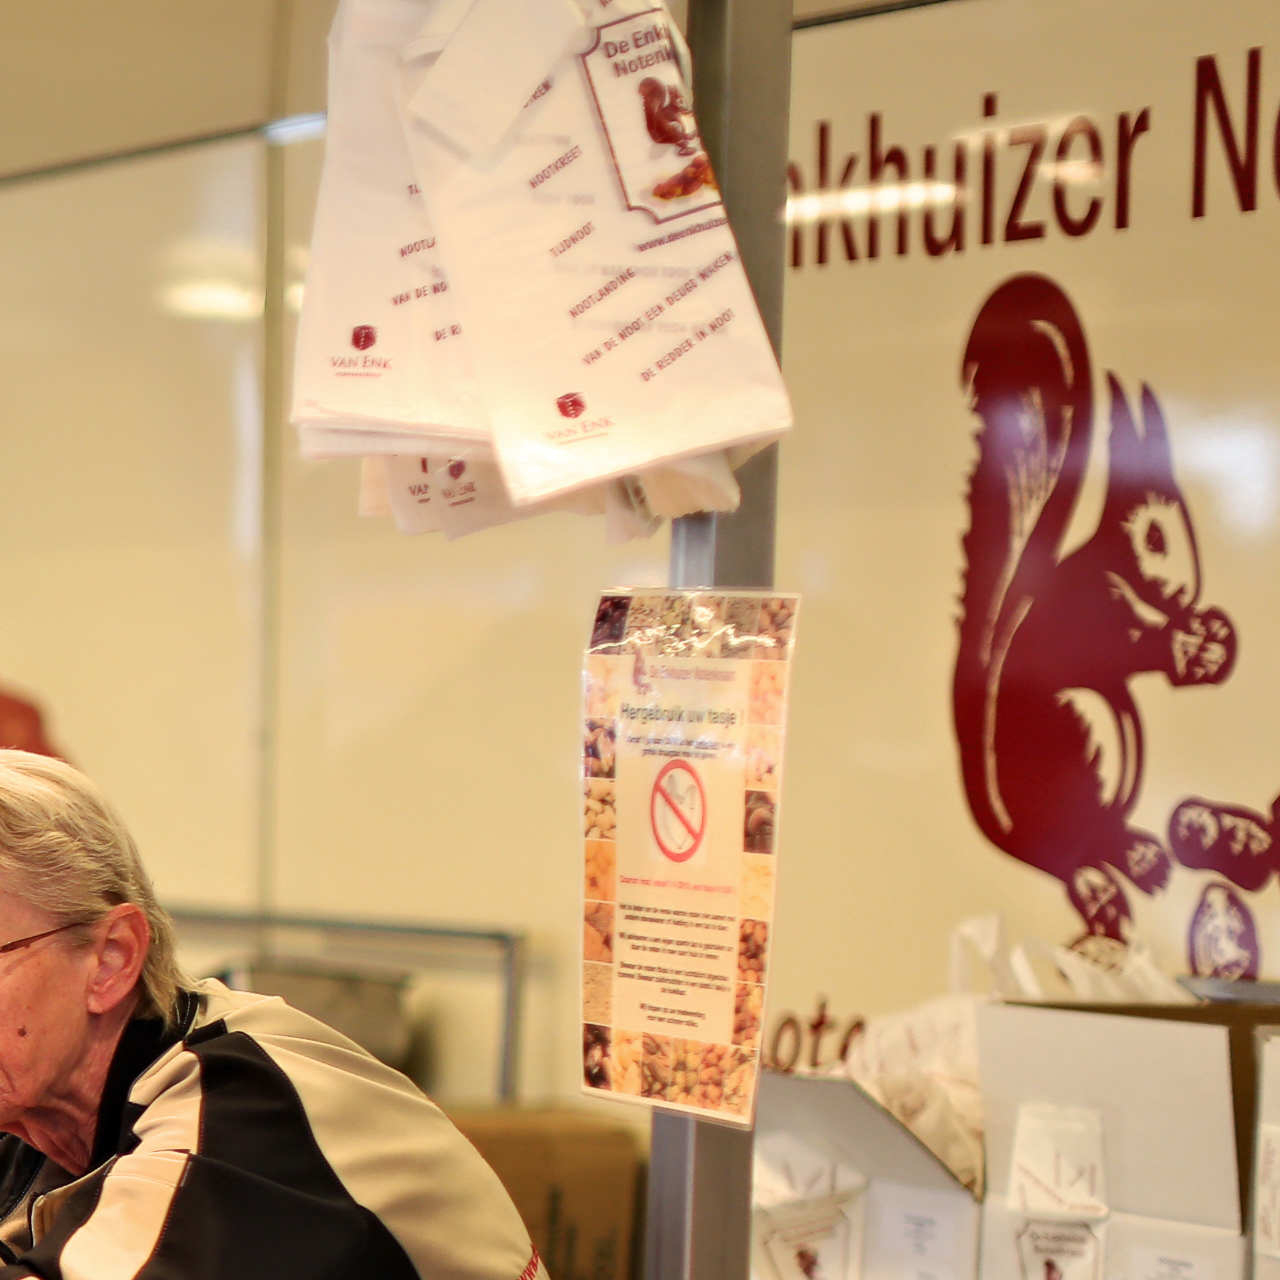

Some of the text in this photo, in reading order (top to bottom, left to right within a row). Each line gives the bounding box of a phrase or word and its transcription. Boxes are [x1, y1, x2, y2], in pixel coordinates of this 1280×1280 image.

[604, 39, 629, 58] De
[787, 46, 1280, 268] nkhuizer N
[392, 281, 448, 306] VAN DE NO
[569, 267, 637, 318] NOOTLANDING
[582, 346, 604, 365] VAN
[603, 337, 618, 351] DE
[618, 318, 645, 341] NOOT
[644, 303, 666, 322] EEN
[665, 279, 699, 306] DEUGD
[698, 252, 735, 281] MAKEN
[434, 328, 448, 341] DE
[641, 368, 656, 382] DE
[656, 338, 696, 371] REDDER
[695, 327, 709, 342] IN
[708, 308, 737, 332] NOOT
[331, 355, 394, 369] VAN ENK
[545, 425, 578, 440] VAN
[580, 415, 616, 433] ENK
[621, 703, 684, 724] Hergebruik
[688, 710, 706, 723] uw
[708, 708, 737, 728] tasje
